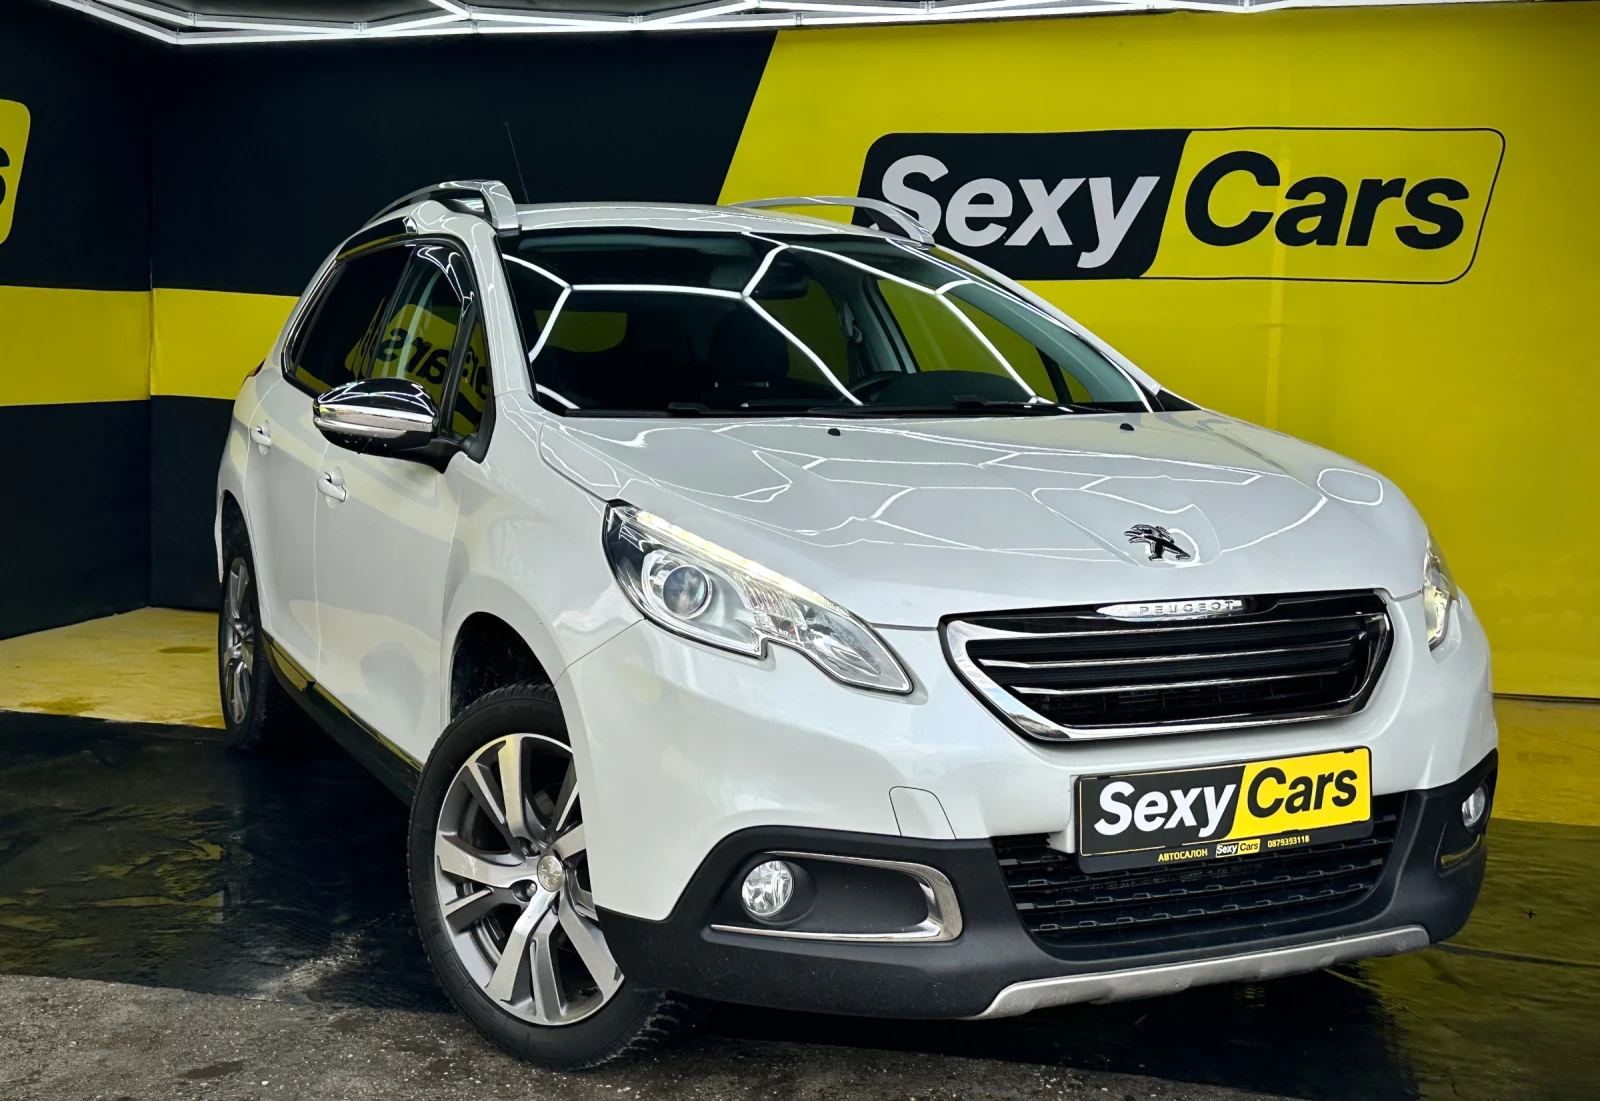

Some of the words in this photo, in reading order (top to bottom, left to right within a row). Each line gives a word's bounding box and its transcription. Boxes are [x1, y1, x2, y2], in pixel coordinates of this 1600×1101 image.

[872, 153, 1160, 268] Sexy
[1184, 150, 1470, 249] Cars
[1140, 601, 1234, 614] PEUGEOT
[1094, 781, 1237, 838] Sexy
[1247, 767, 1358, 818] Cars
[1157, 848, 1208, 862] АВТОСАЛОН
[1216, 842, 1238, 855] Sexy
[1239, 841, 1259, 852] Cars
